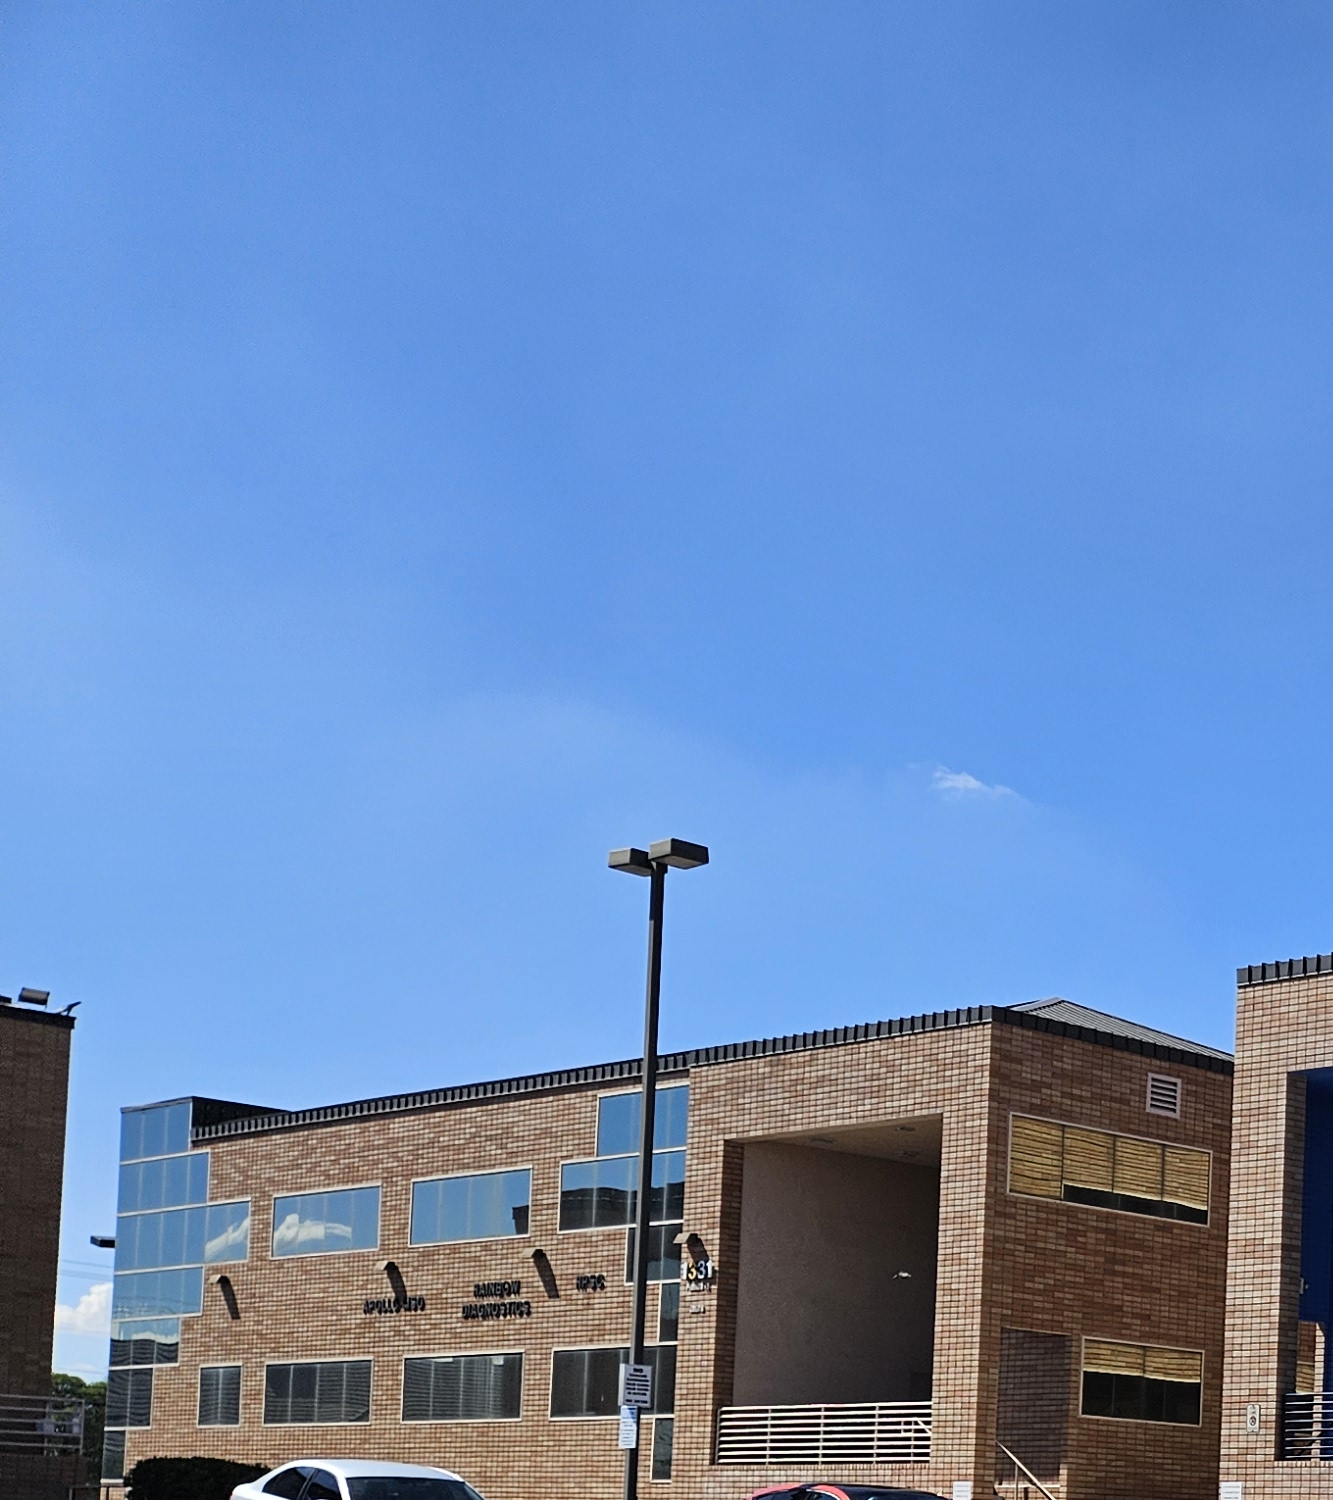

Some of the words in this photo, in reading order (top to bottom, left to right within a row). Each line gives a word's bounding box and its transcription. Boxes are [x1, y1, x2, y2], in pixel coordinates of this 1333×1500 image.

[681, 1259, 713, 1280] 1331
[474, 1280, 521, 1298] RAINBOW
[363, 1298, 400, 1315] APOLLO
[462, 1301, 532, 1319] DIAGNOSTICS
